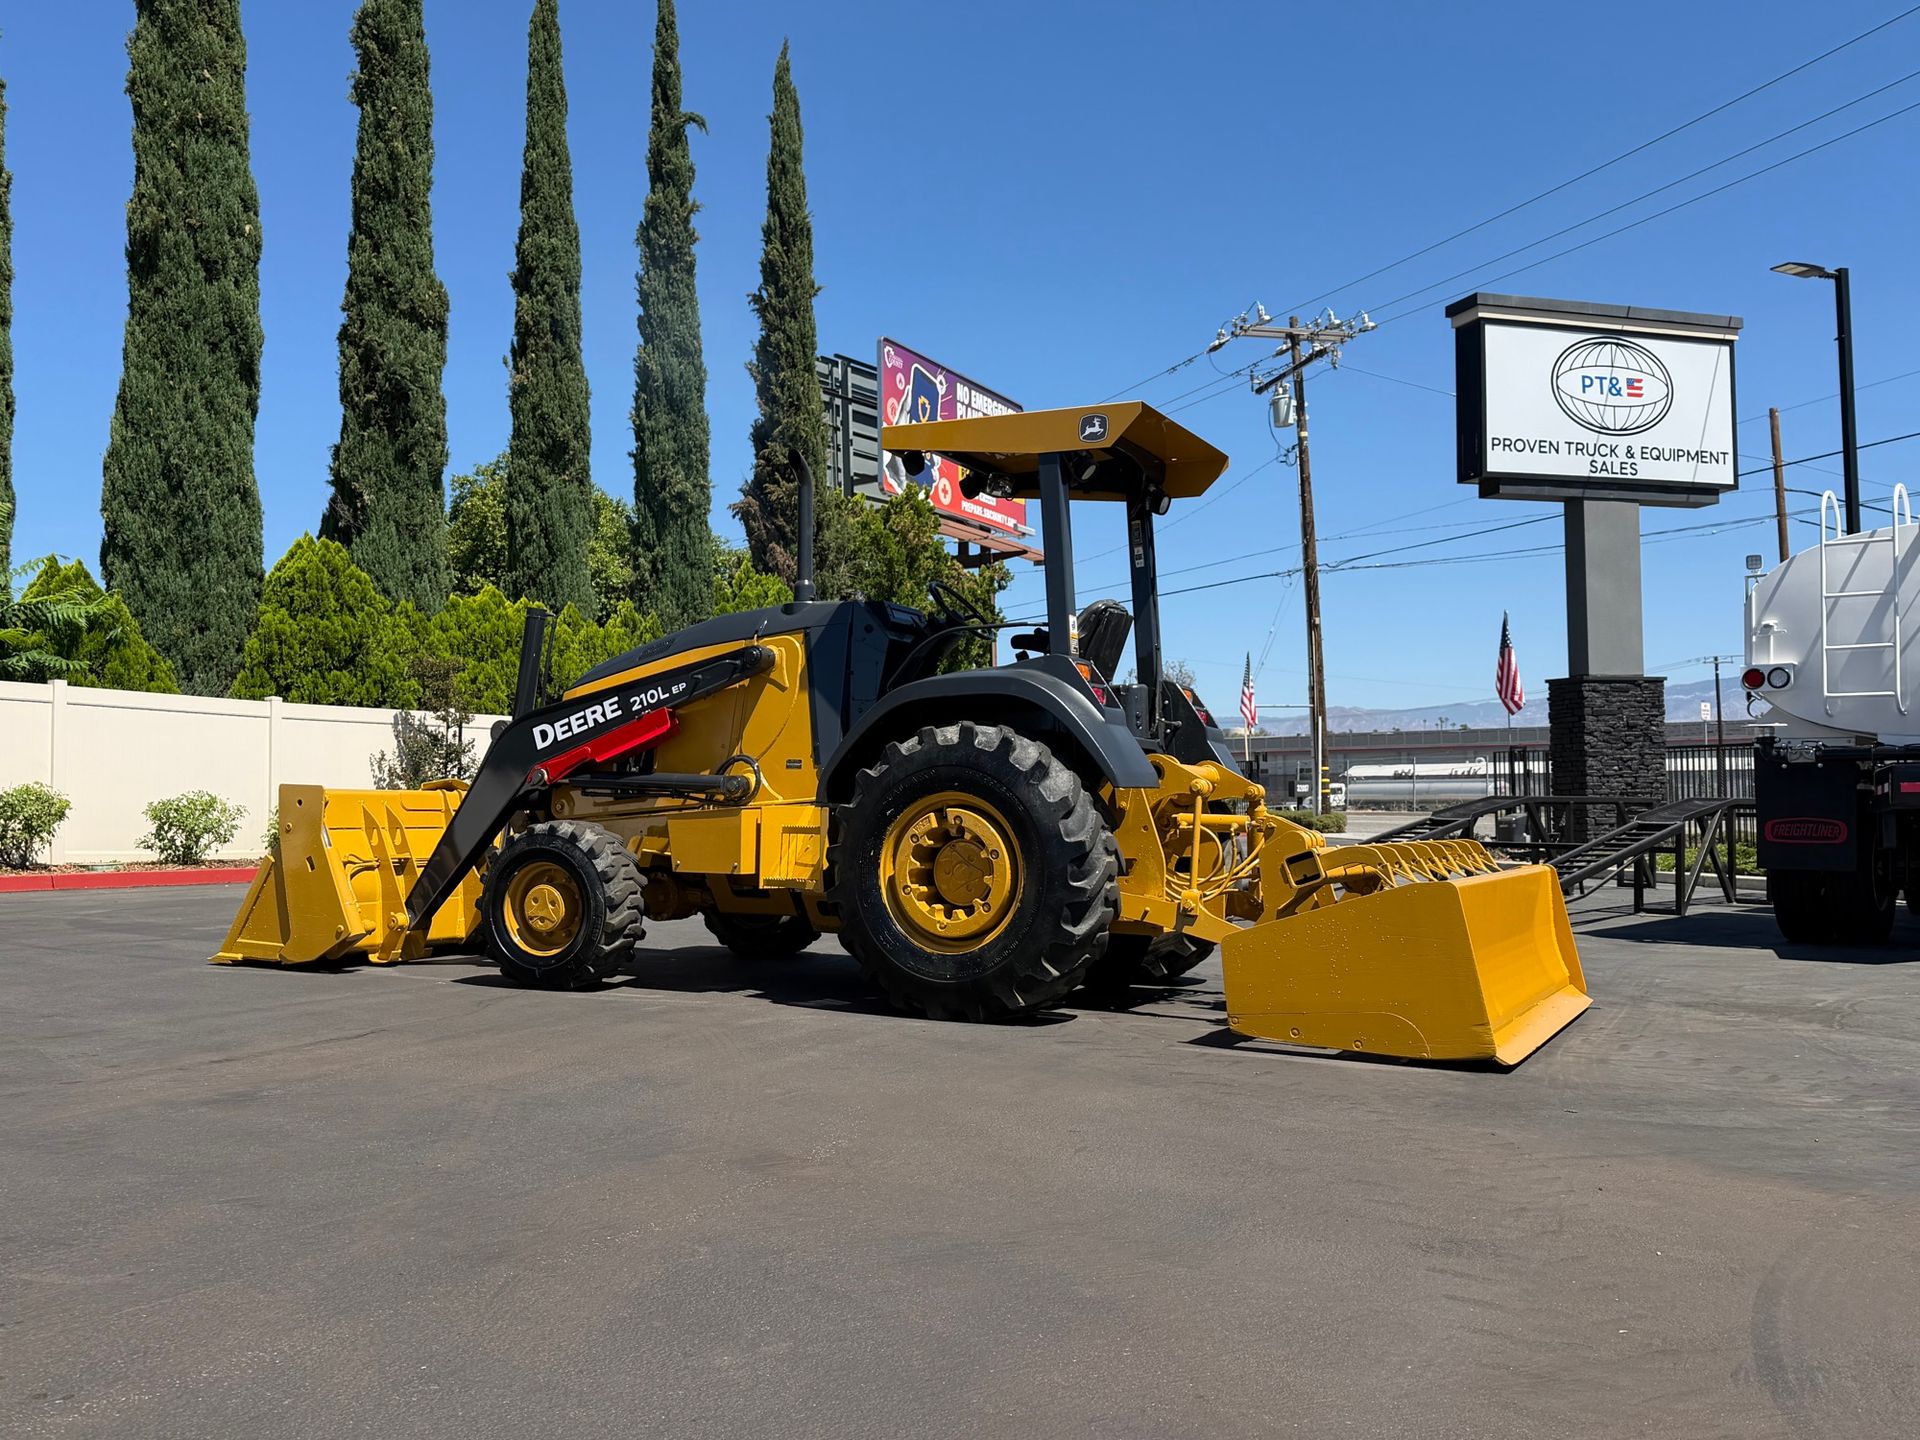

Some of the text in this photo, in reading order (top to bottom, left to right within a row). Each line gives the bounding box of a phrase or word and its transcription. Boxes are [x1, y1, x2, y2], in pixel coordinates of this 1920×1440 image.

[956, 382, 970, 405] NO
[1581, 374, 1643, 399] PT&E
[1491, 436, 1729, 465] PROVEN TRUCK & EQUIPMENT
[1589, 459, 1638, 477] SALES
[532, 696, 623, 751] DEERE
[629, 687, 670, 713] 210L
[671, 682, 688, 695] EP
[1773, 822, 1840, 839] FREIGHTLINER
